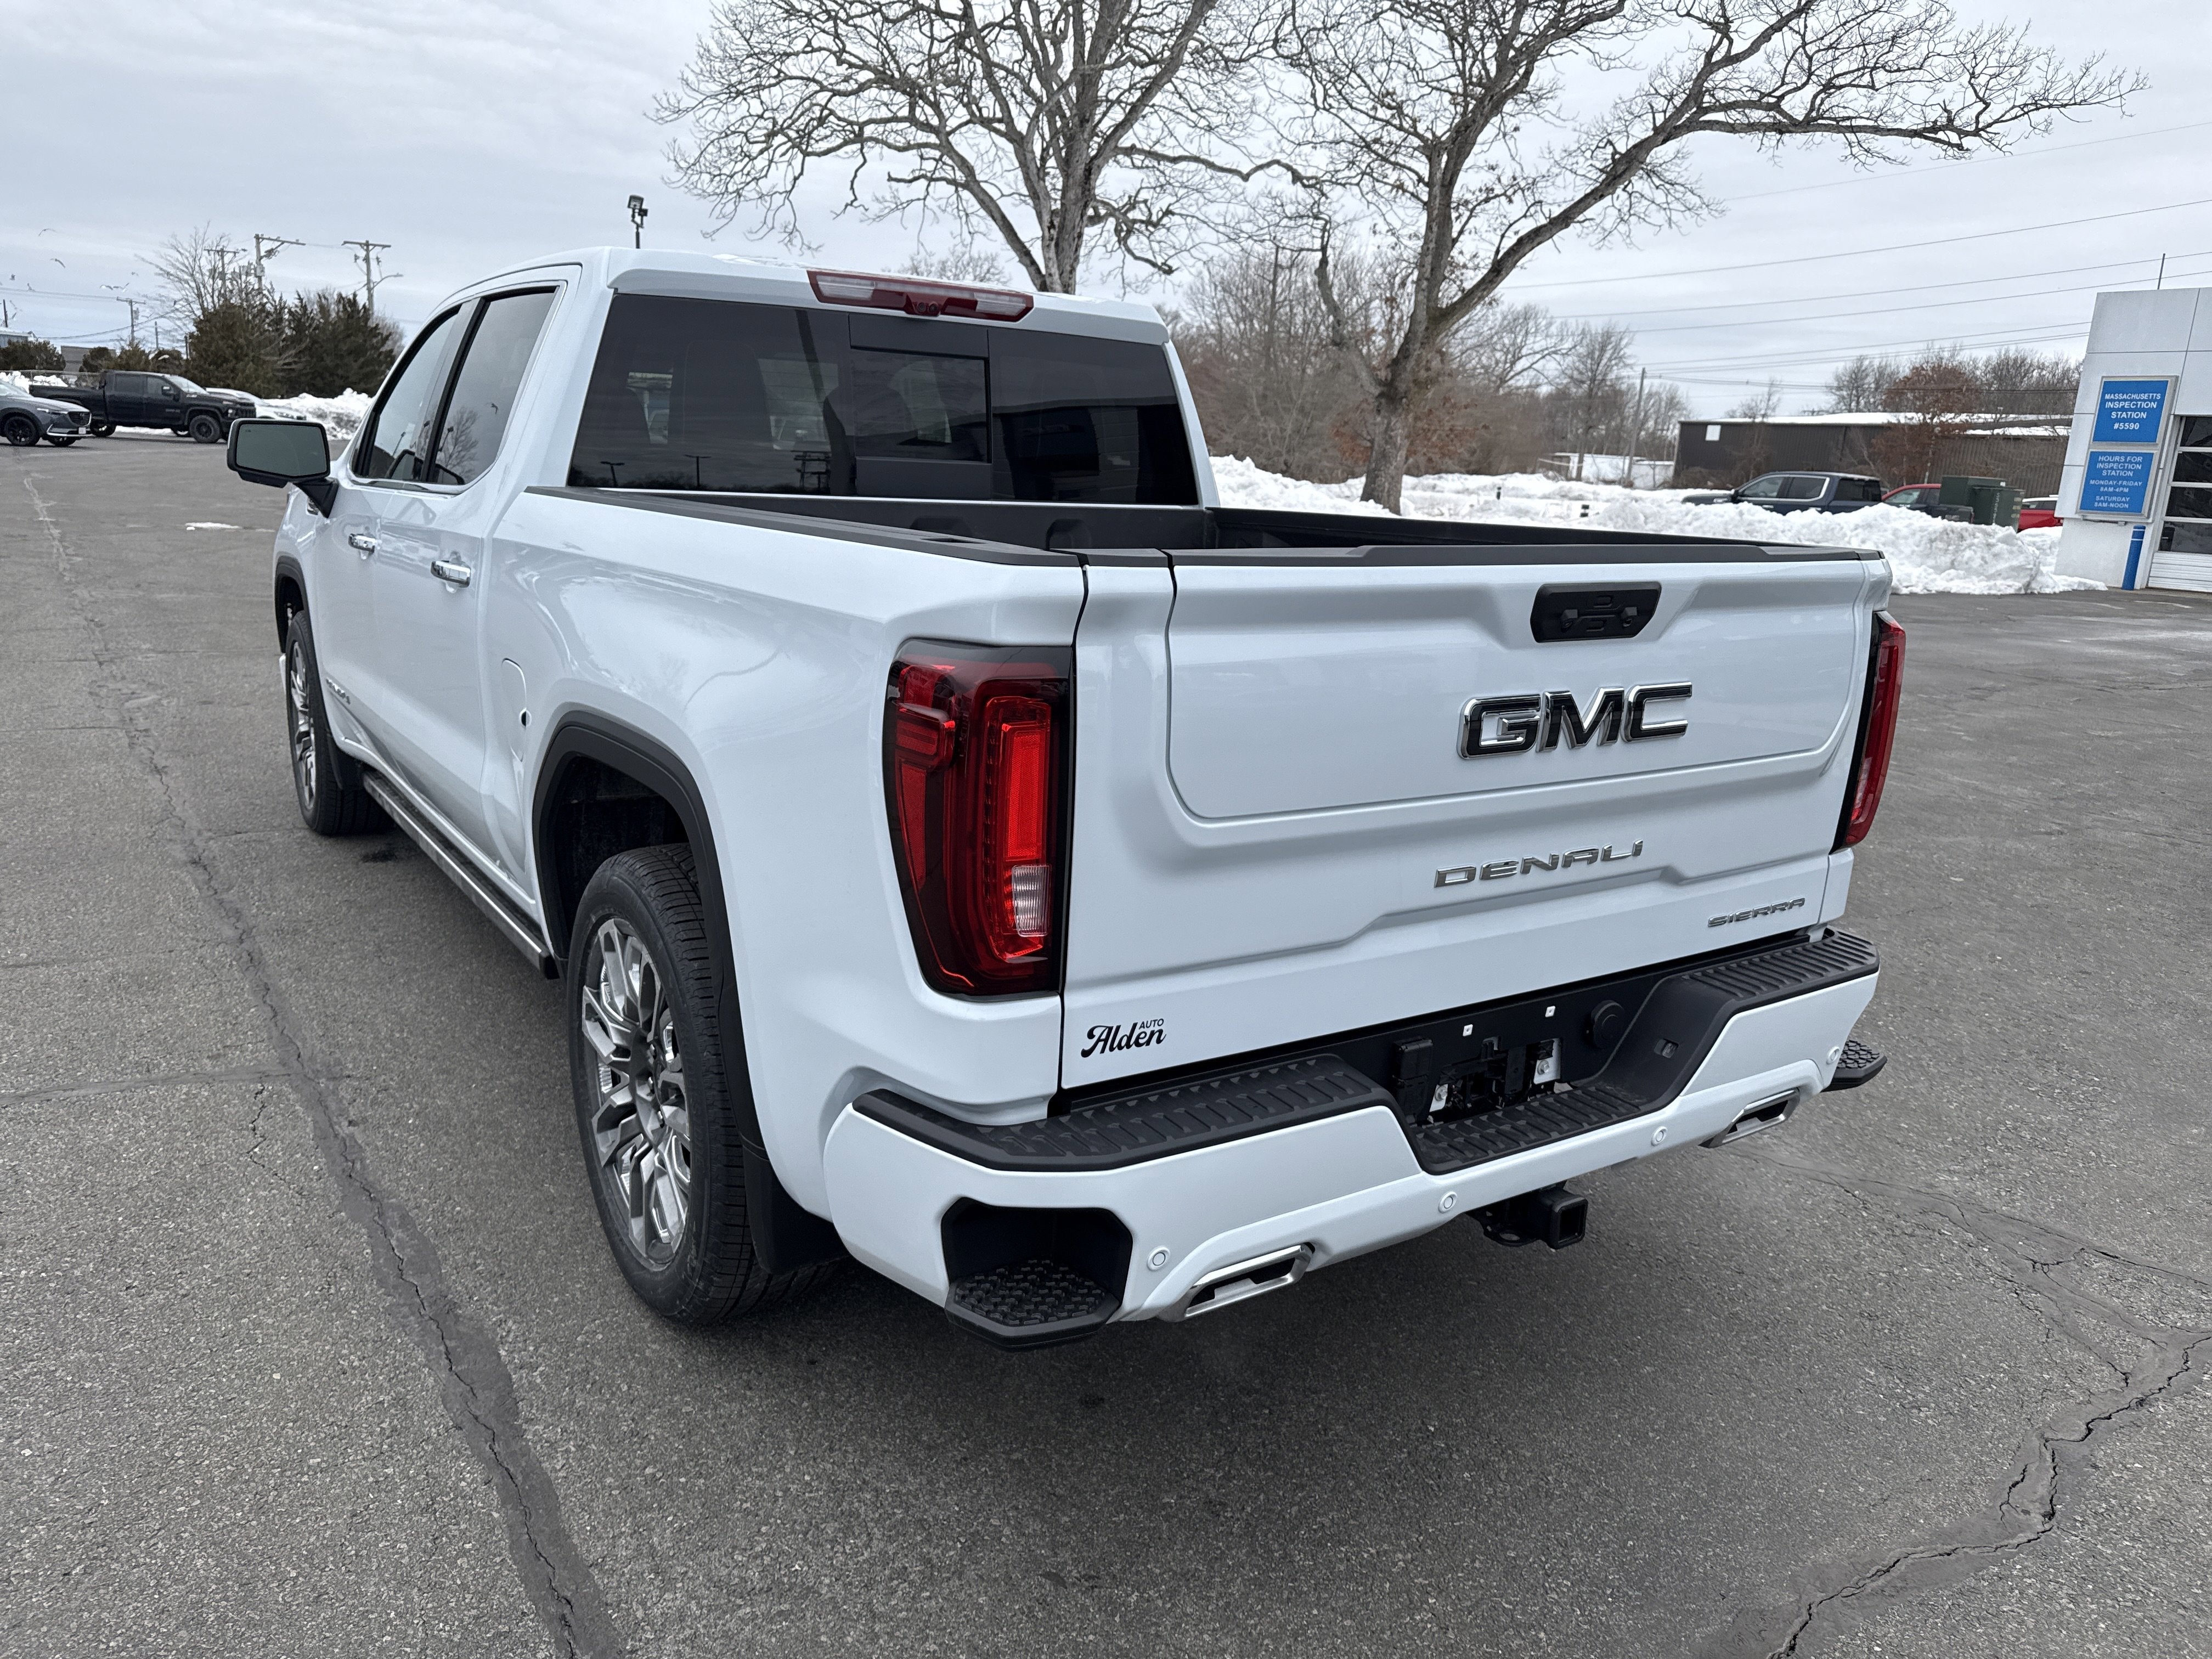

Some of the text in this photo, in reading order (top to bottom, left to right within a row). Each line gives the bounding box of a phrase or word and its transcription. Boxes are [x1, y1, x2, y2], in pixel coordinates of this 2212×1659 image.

[1457, 682, 1692, 759] GMC
[1434, 839, 1644, 888] DENALI
[1707, 898, 1806, 928] SIERRA
[1081, 1022, 1167, 1058] Alden
[1138, 1018, 1164, 1030] AUTO
